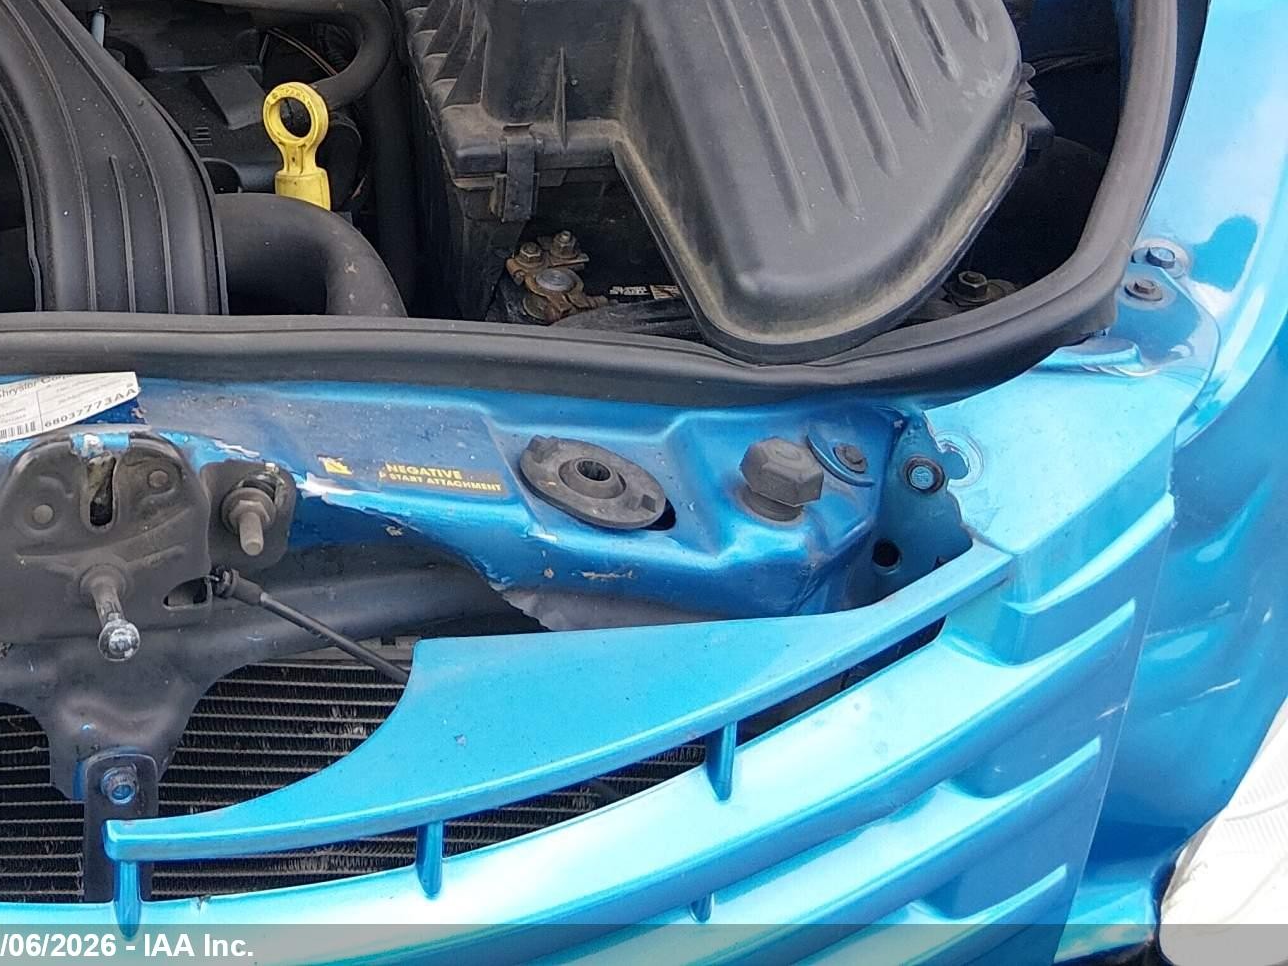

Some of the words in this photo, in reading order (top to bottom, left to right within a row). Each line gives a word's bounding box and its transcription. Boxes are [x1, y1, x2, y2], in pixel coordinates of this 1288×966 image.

[386, 463, 463, 480] NEGATIVE
[389, 473, 423, 484] START
[426, 477, 502, 492] ATTACHMENT
